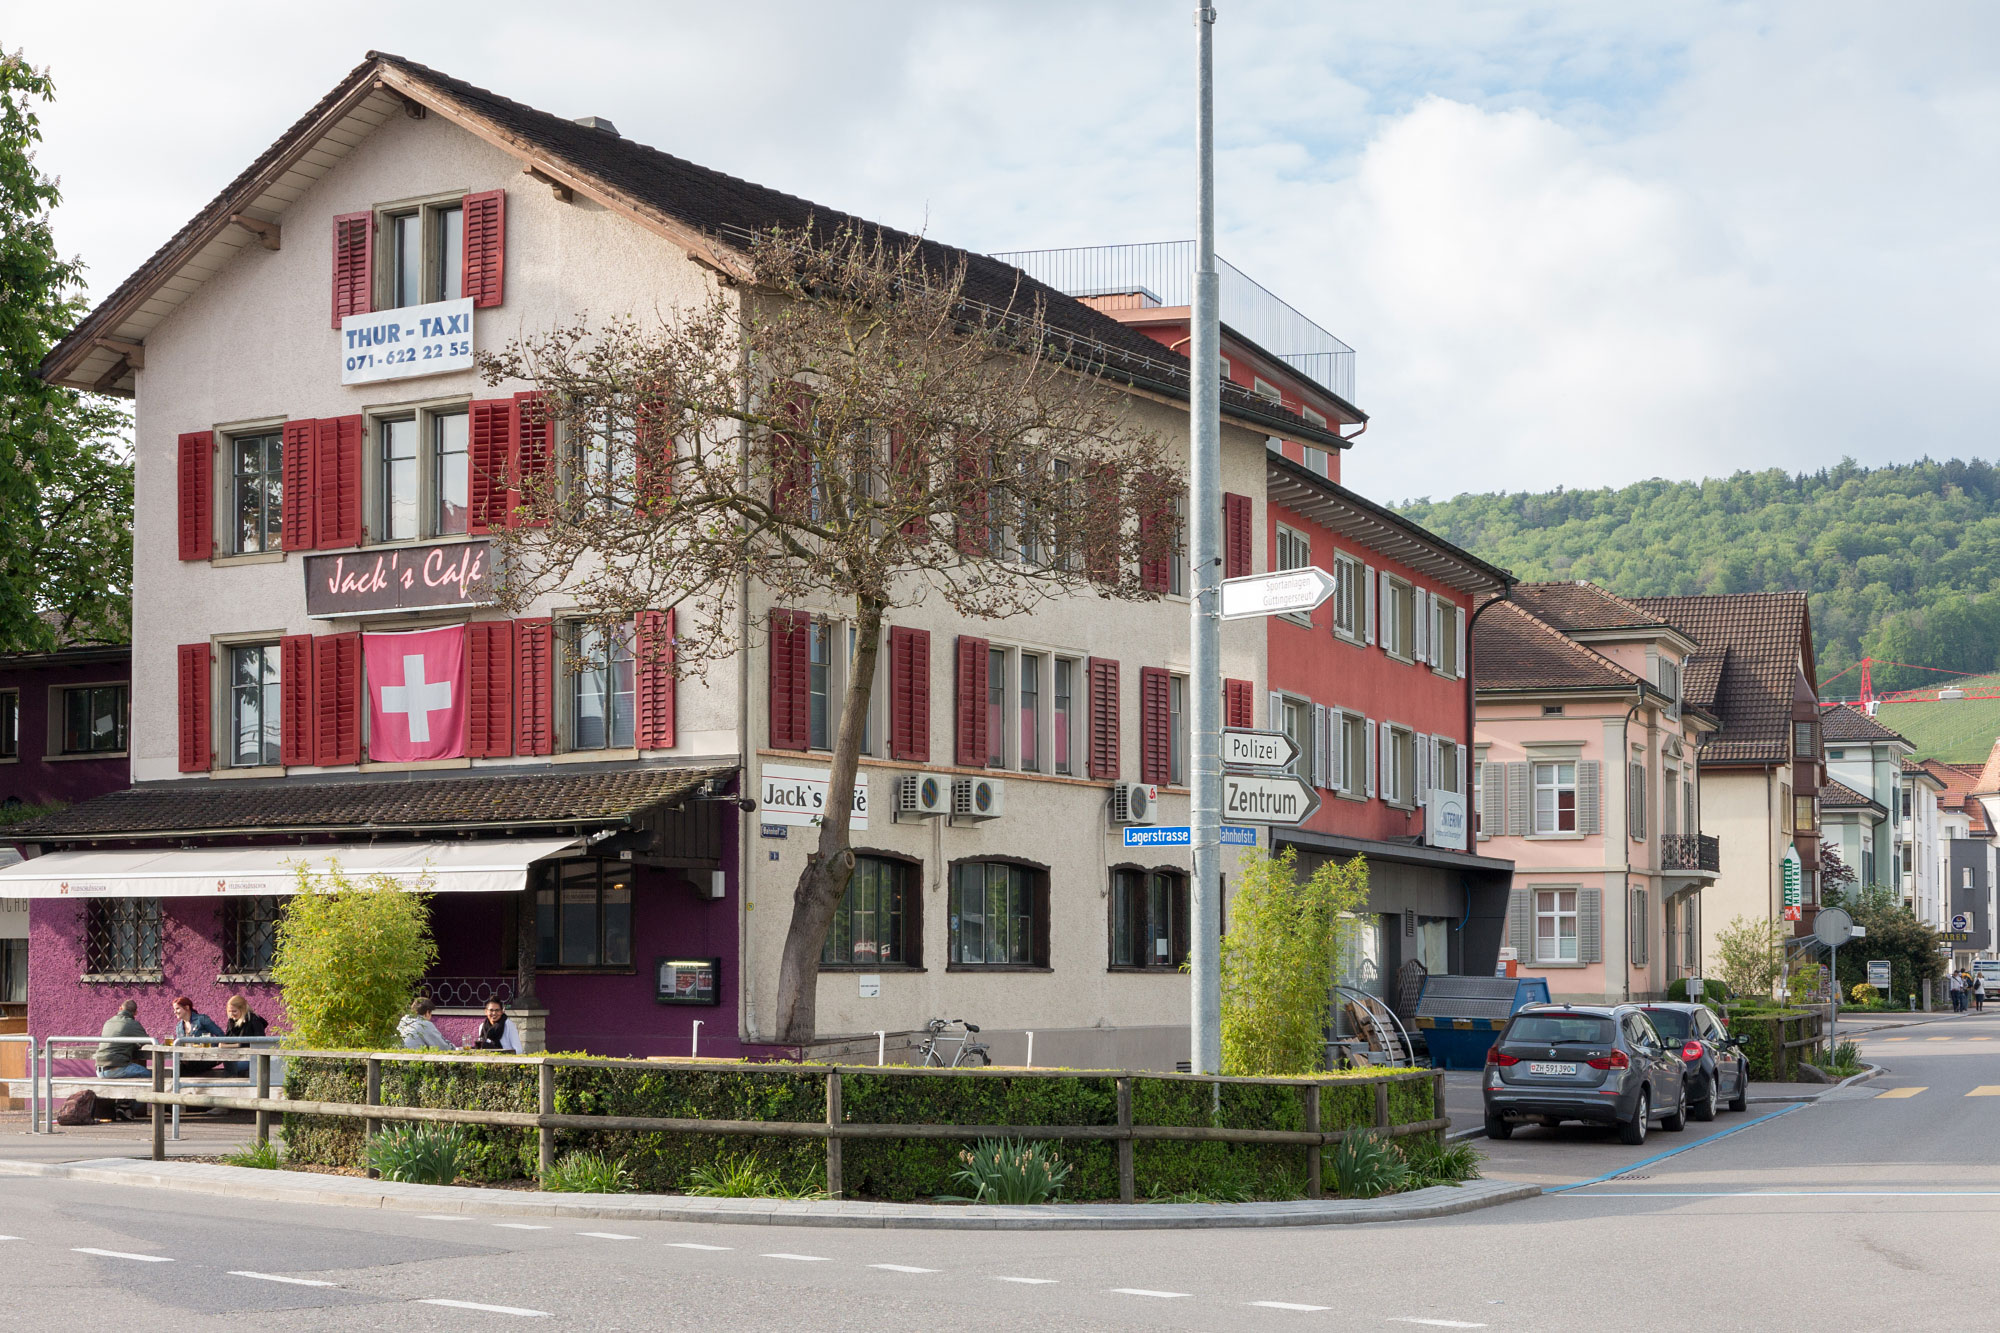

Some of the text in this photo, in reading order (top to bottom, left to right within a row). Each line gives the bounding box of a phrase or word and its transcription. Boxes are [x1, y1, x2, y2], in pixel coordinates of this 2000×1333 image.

[346, 323, 401, 350] THUR
[419, 313, 470, 339] TAXI
[422, 343, 443, 360] 22
[449, 341, 470, 357] 55
[423, 548, 483, 600] Café
[1233, 738, 1277, 760] Polizei
[851, 789, 866, 812] fé
[1228, 782, 1297, 815] Zentrum
[1126, 829, 1188, 846] Lagerstrasse
[1219, 828, 1254, 844] ahnhofstr.
[1785, 861, 1793, 905] PAPETERIE
[1535, 1064, 1545, 1072] ZH
